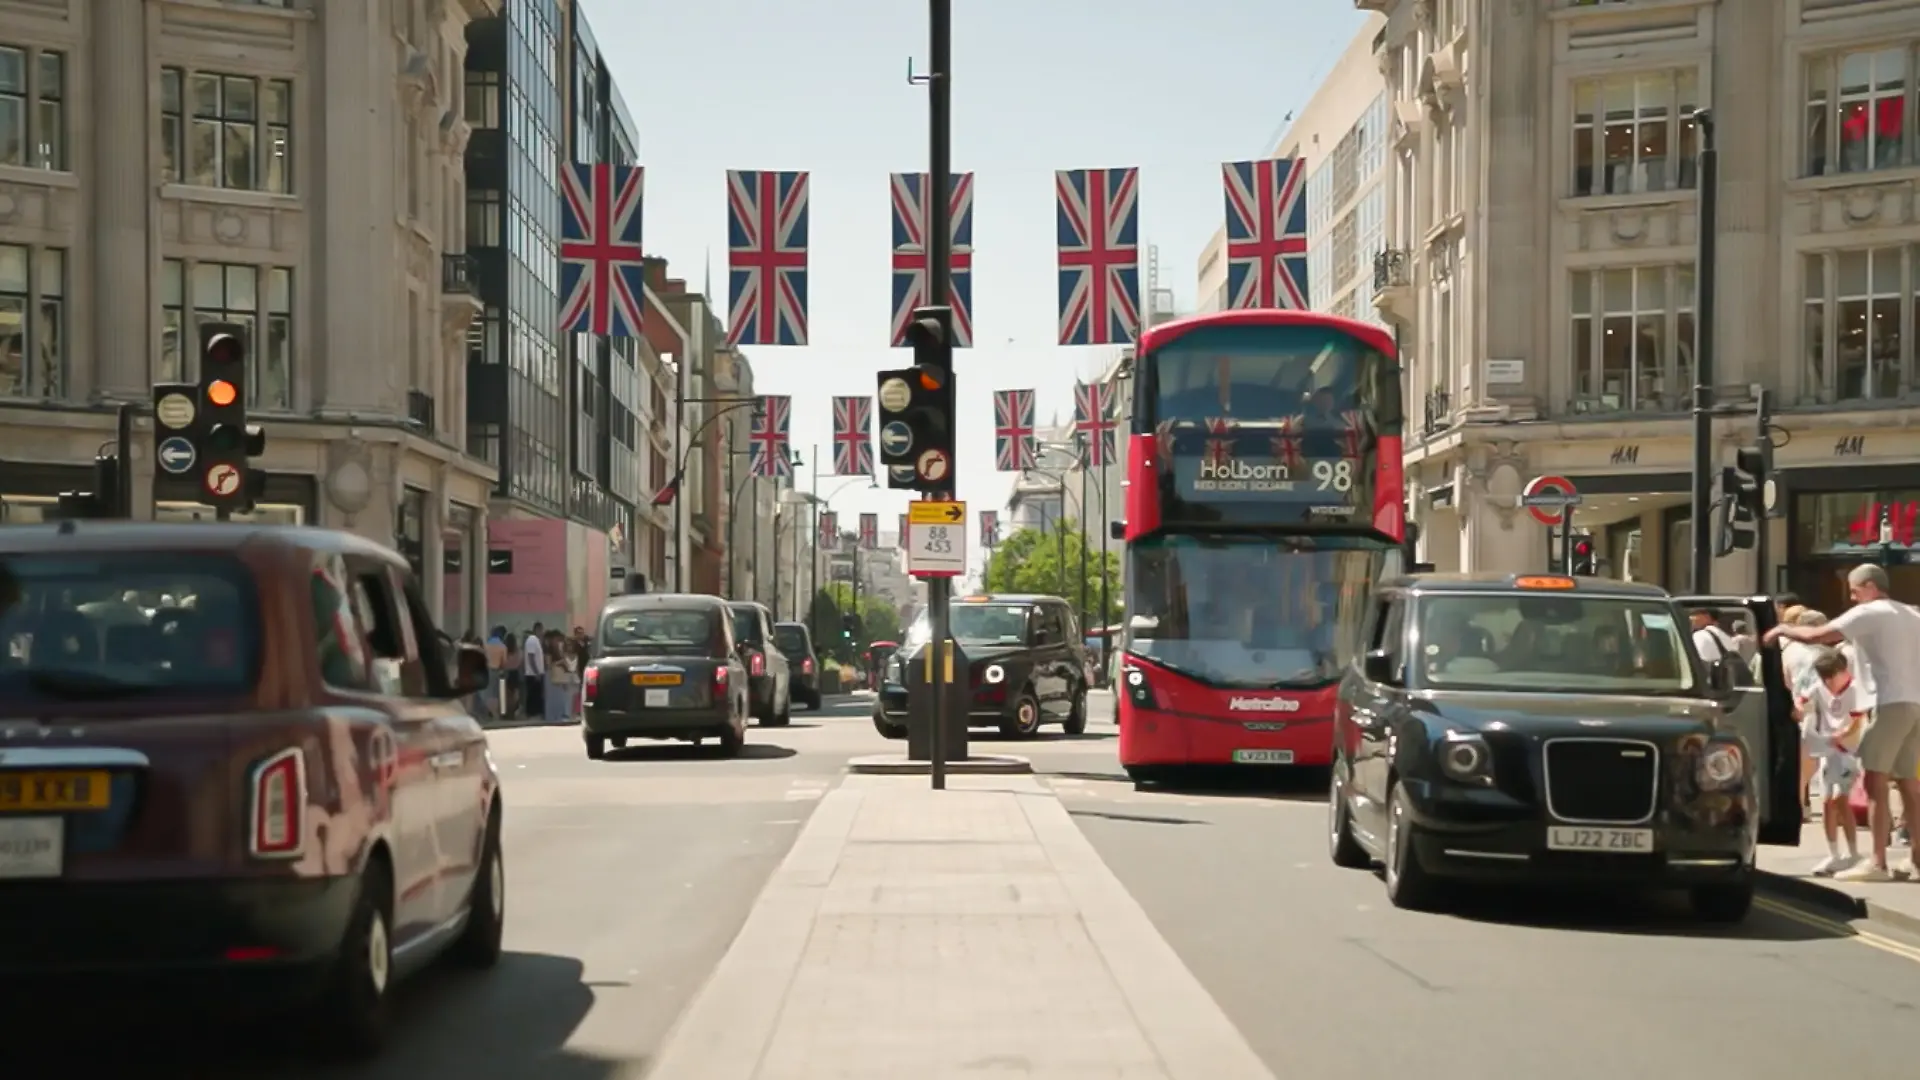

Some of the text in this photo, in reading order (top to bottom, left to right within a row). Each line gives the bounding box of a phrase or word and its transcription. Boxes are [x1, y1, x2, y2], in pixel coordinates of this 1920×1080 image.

[1201, 460, 1289, 479] Holborn
[1312, 461, 1351, 491] 98
[924, 539, 952, 553] 453
[1553, 830, 1603, 847] LJ22
